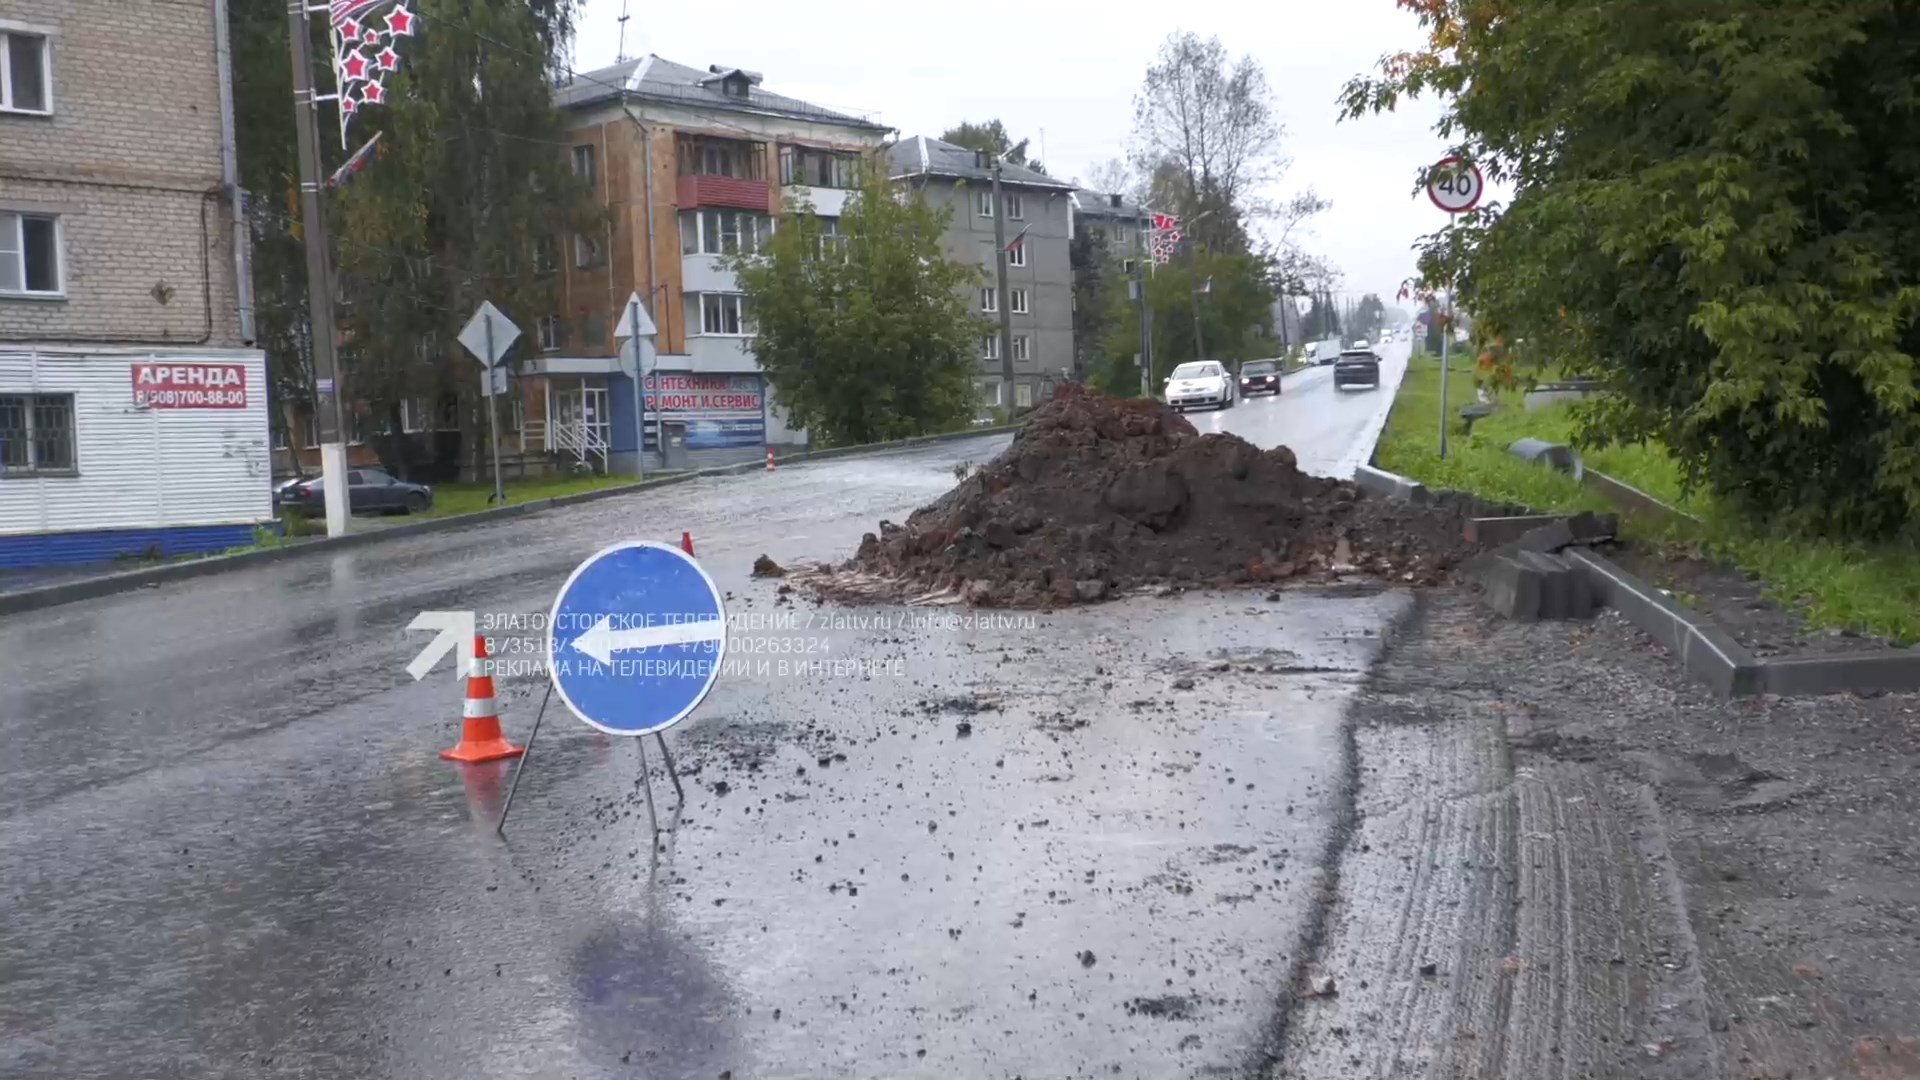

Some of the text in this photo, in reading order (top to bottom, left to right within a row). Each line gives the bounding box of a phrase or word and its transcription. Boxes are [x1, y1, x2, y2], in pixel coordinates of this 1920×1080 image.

[1438, 174, 1471, 197] 40
[138, 366, 241, 388] АРЕНДА
[136, 389, 244, 407] 8(908)700-88-00
[701, 394, 710, 409] И
[712, 394, 760, 409] СЕРВИС
